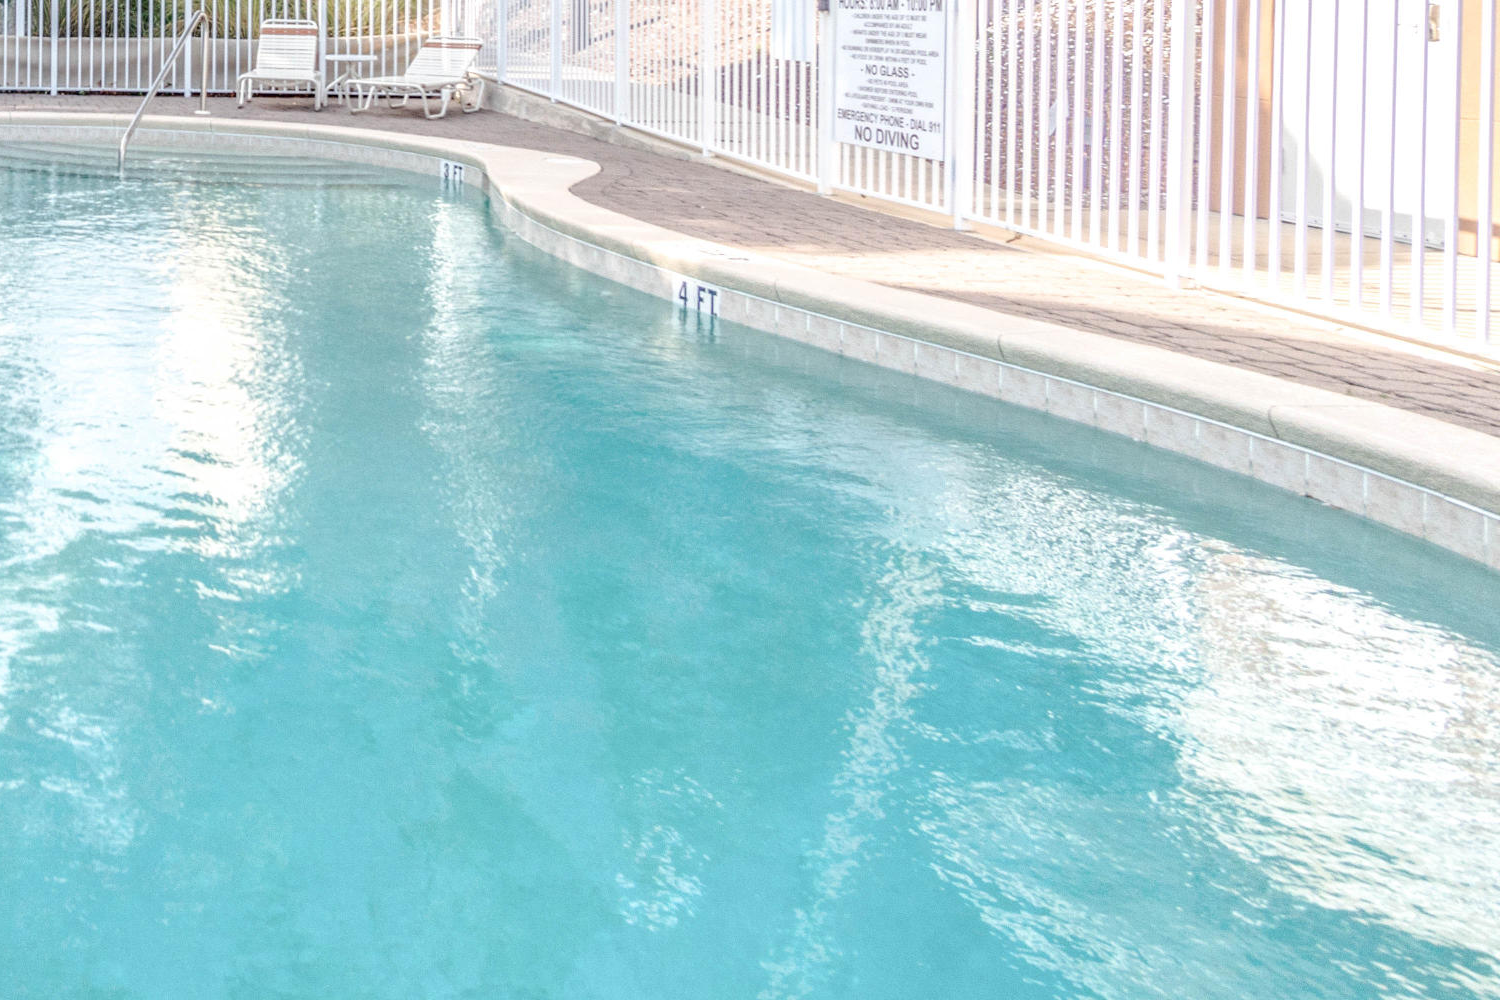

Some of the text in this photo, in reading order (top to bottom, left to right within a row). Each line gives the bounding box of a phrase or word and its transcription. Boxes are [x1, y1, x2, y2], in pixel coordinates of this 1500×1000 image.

[865, 64, 878, 76] NO
[880, 65, 909, 79] GLASS
[837, 108, 878, 124] EMERGENCY
[880, 114, 904, 129] PHONE
[910, 118, 927, 132] DIAL
[929, 121, 941, 133] 911
[854, 125, 920, 150] NO DIVING
[678, 281, 688, 307] 4
